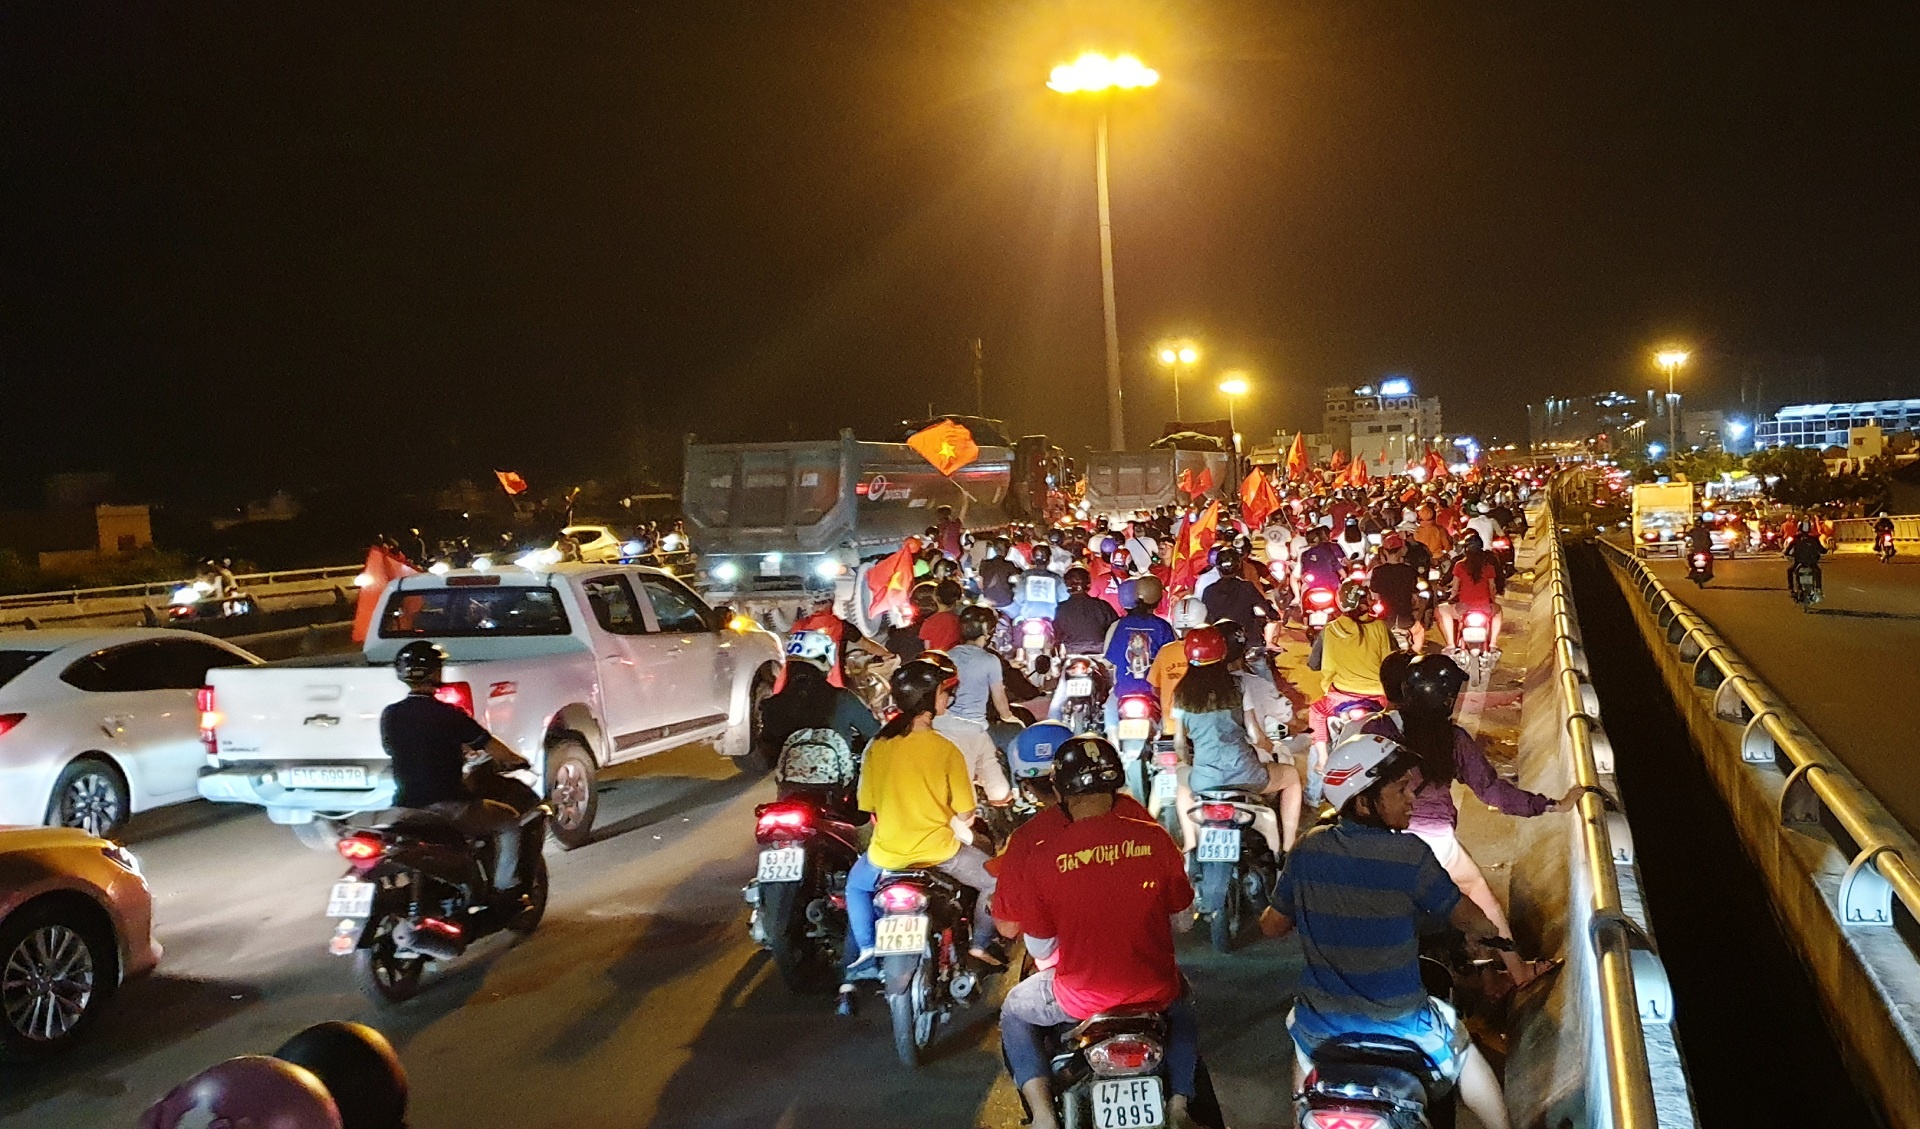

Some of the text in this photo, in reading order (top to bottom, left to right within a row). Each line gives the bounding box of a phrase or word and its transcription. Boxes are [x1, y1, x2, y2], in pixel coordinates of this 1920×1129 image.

[766, 851, 796, 865] 63-P1
[1092, 844, 1119, 866] Việt
[1121, 840, 1152, 858] Nam
[1101, 1080, 1150, 1104] 47-FF
[1103, 1103, 1154, 1128] 2895
